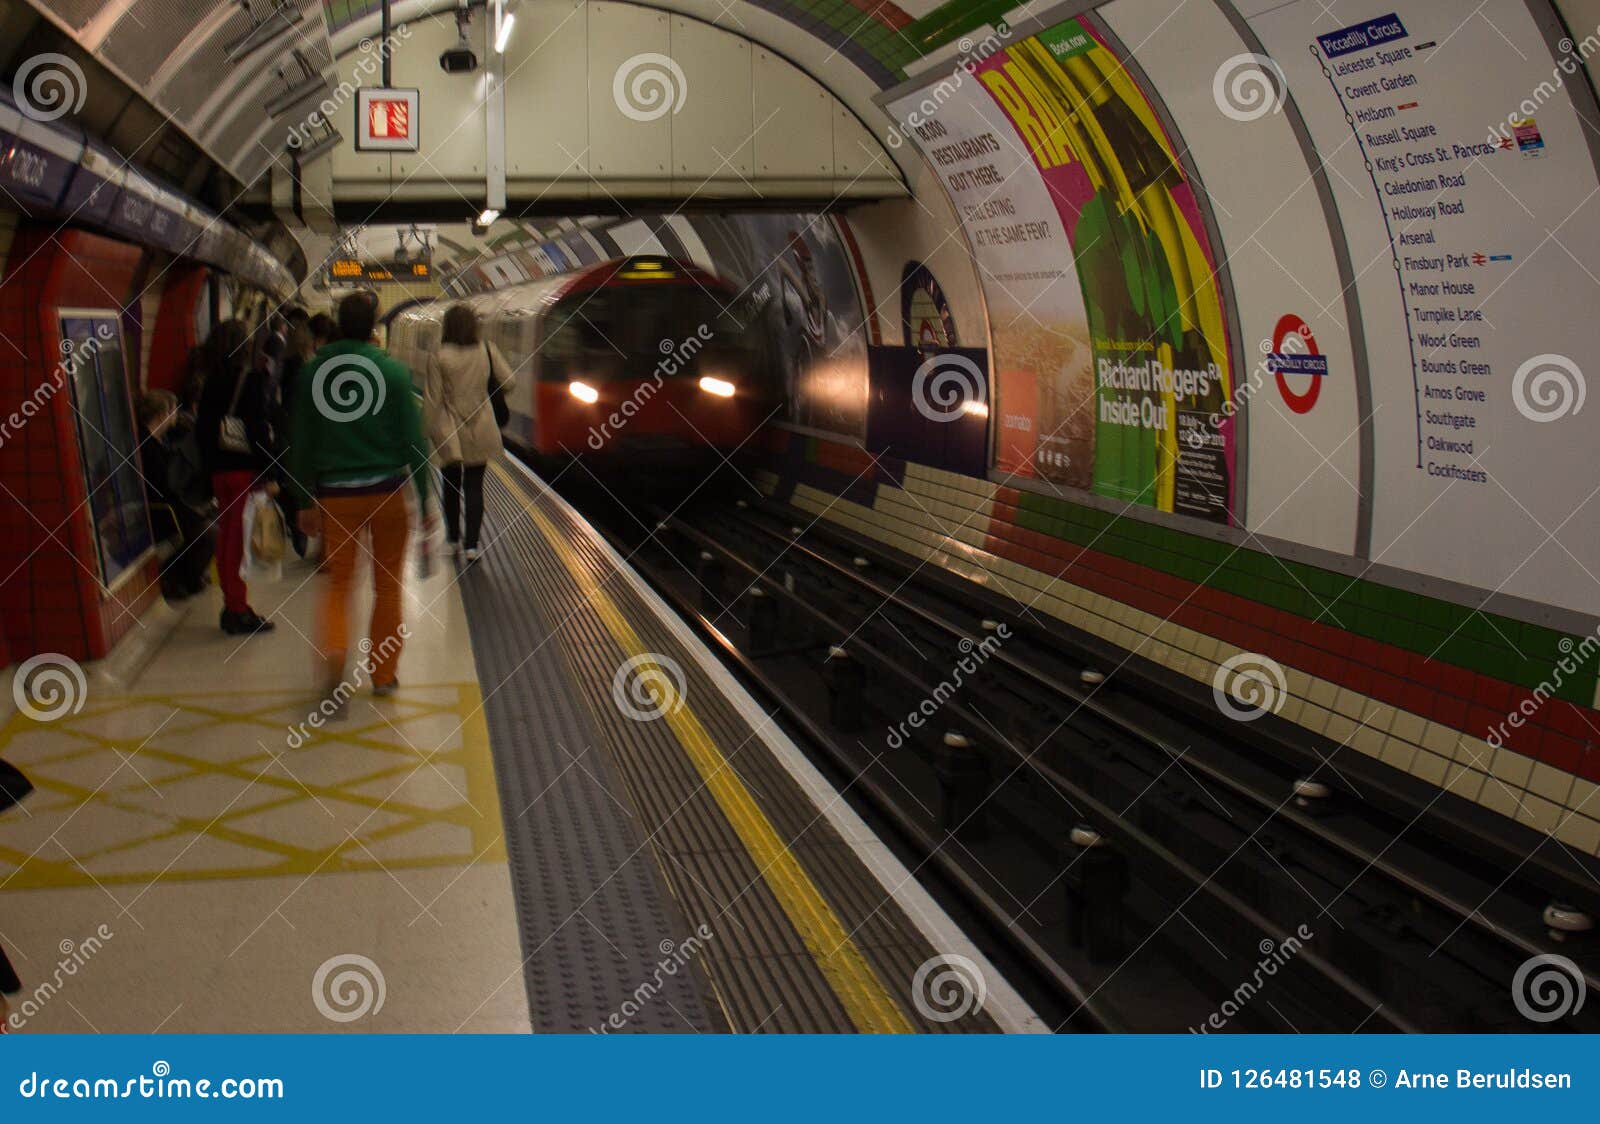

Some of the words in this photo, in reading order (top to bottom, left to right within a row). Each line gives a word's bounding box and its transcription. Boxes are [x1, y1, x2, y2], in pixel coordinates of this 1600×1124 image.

[1323, 30, 1369, 53] Piccadilly
[1368, 22, 1402, 41] Circus
[1333, 57, 1376, 77] Leicester
[1377, 46, 1412, 67] Square
[1345, 82, 1380, 100] Covent
[1380, 72, 1417, 92] Garden
[1356, 104, 1395, 123] Holborn
[1366, 127, 1400, 148] Russell
[1401, 123, 1437, 144] Square
[931, 132, 1001, 167] RESTAURANTS
[1375, 156, 1406, 174] King's
[1406, 151, 1434, 168] Cross
[1453, 141, 1496, 160] Pancras
[948, 170, 972, 192] OUT
[1384, 175, 1438, 196] Caledonian
[1438, 172, 1466, 190] Road
[984, 197, 1016, 218] EATING
[1392, 202, 1437, 221] Holloway
[1439, 200, 1464, 215] Road
[986, 226, 1003, 245] THE
[1002, 223, 1027, 243] SAME
[1400, 230, 1436, 246] Arsenal
[1404, 256, 1444, 272] Finsbury
[1447, 253, 1470, 268] Park
[1410, 282, 1439, 296] Manor
[1443, 281, 1475, 295] House
[1414, 307, 1456, 325] Turnpike
[1458, 308, 1482, 321] Lane
[1418, 333, 1447, 348] Wood
[1450, 333, 1480, 348] Green
[1421, 359, 1456, 374] Bounds
[1460, 360, 1491, 375] Green
[1097, 358, 1150, 390] Richard
[1152, 360, 1210, 401] Rogers
[1208, 361, 1224, 382] RA
[1424, 385, 1452, 400] Arnos
[1455, 386, 1485, 401] Grove
[1100, 393, 1139, 426] Inside
[1141, 401, 1168, 431] Out
[1426, 410, 1476, 429] Southgate
[1427, 436, 1473, 454] Oakwood
[1427, 462, 1487, 483] Cockfosters
